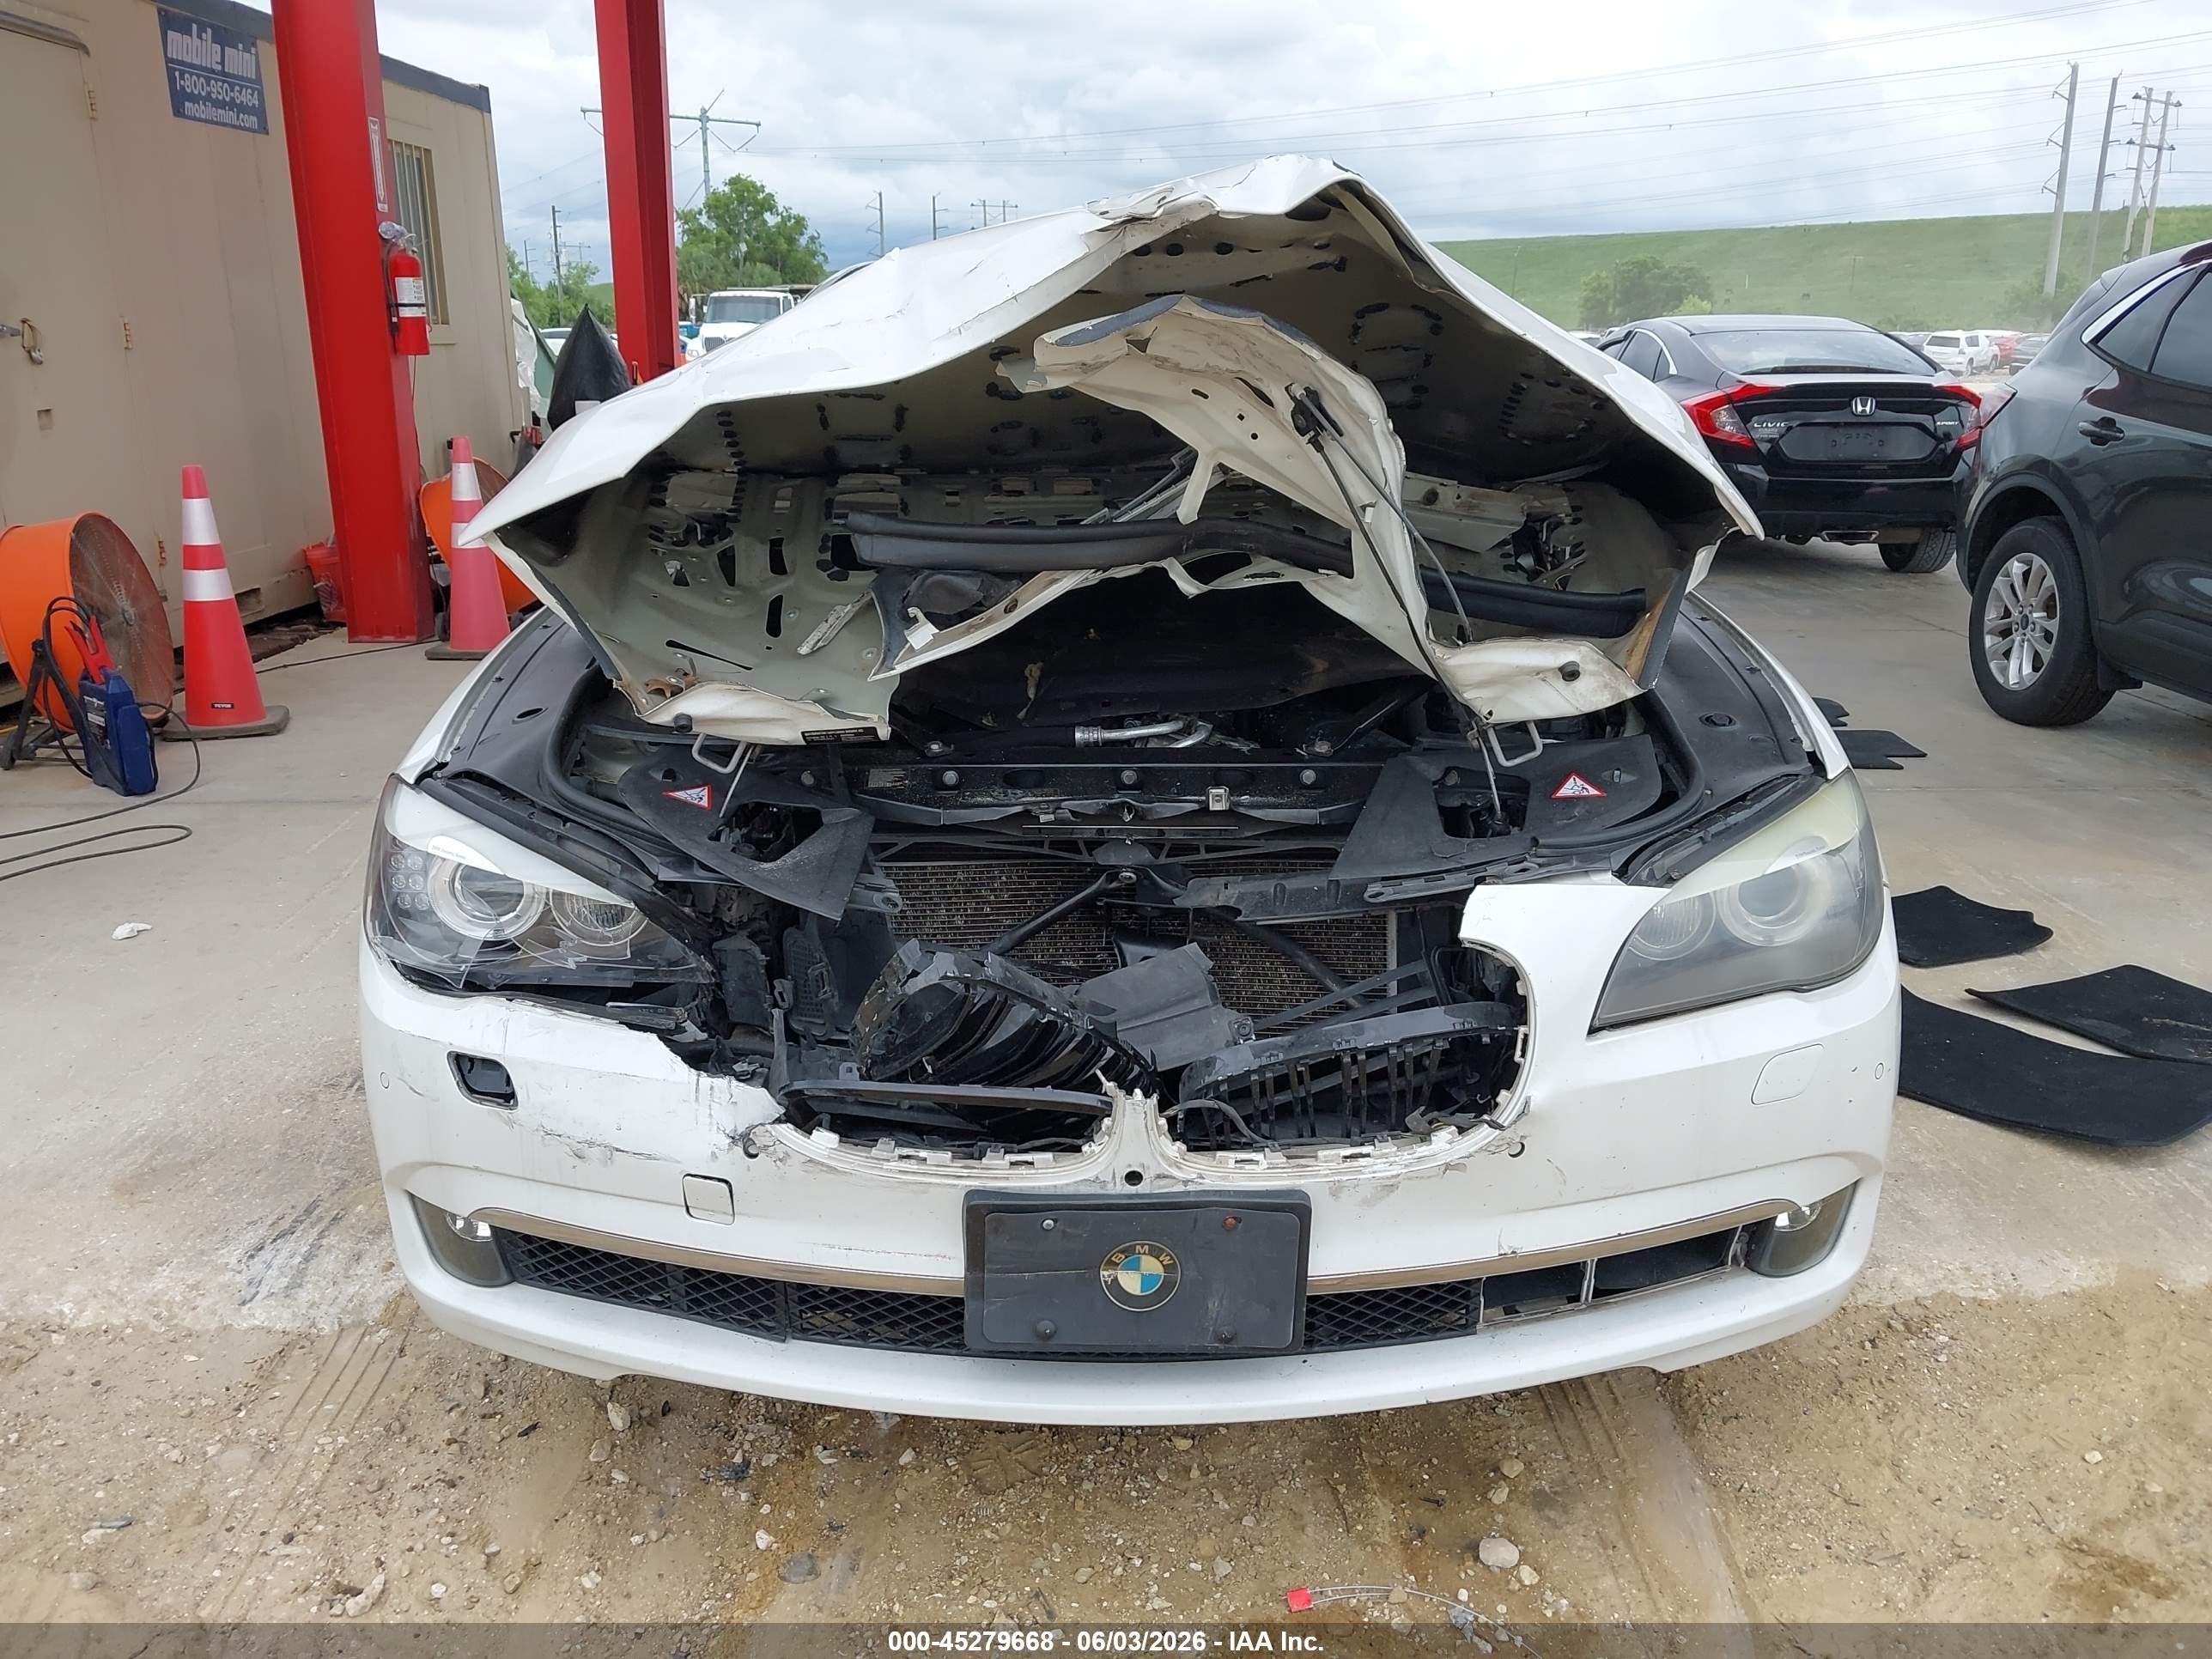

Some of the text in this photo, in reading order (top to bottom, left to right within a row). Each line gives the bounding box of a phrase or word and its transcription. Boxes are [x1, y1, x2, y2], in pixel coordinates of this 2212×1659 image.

[167, 23, 256, 79] mobile mini
[174, 70, 258, 107] 1-800-950-6464
[185, 100, 258, 129] mobilemini.com
[1110, 1244, 1175, 1266] BMW
